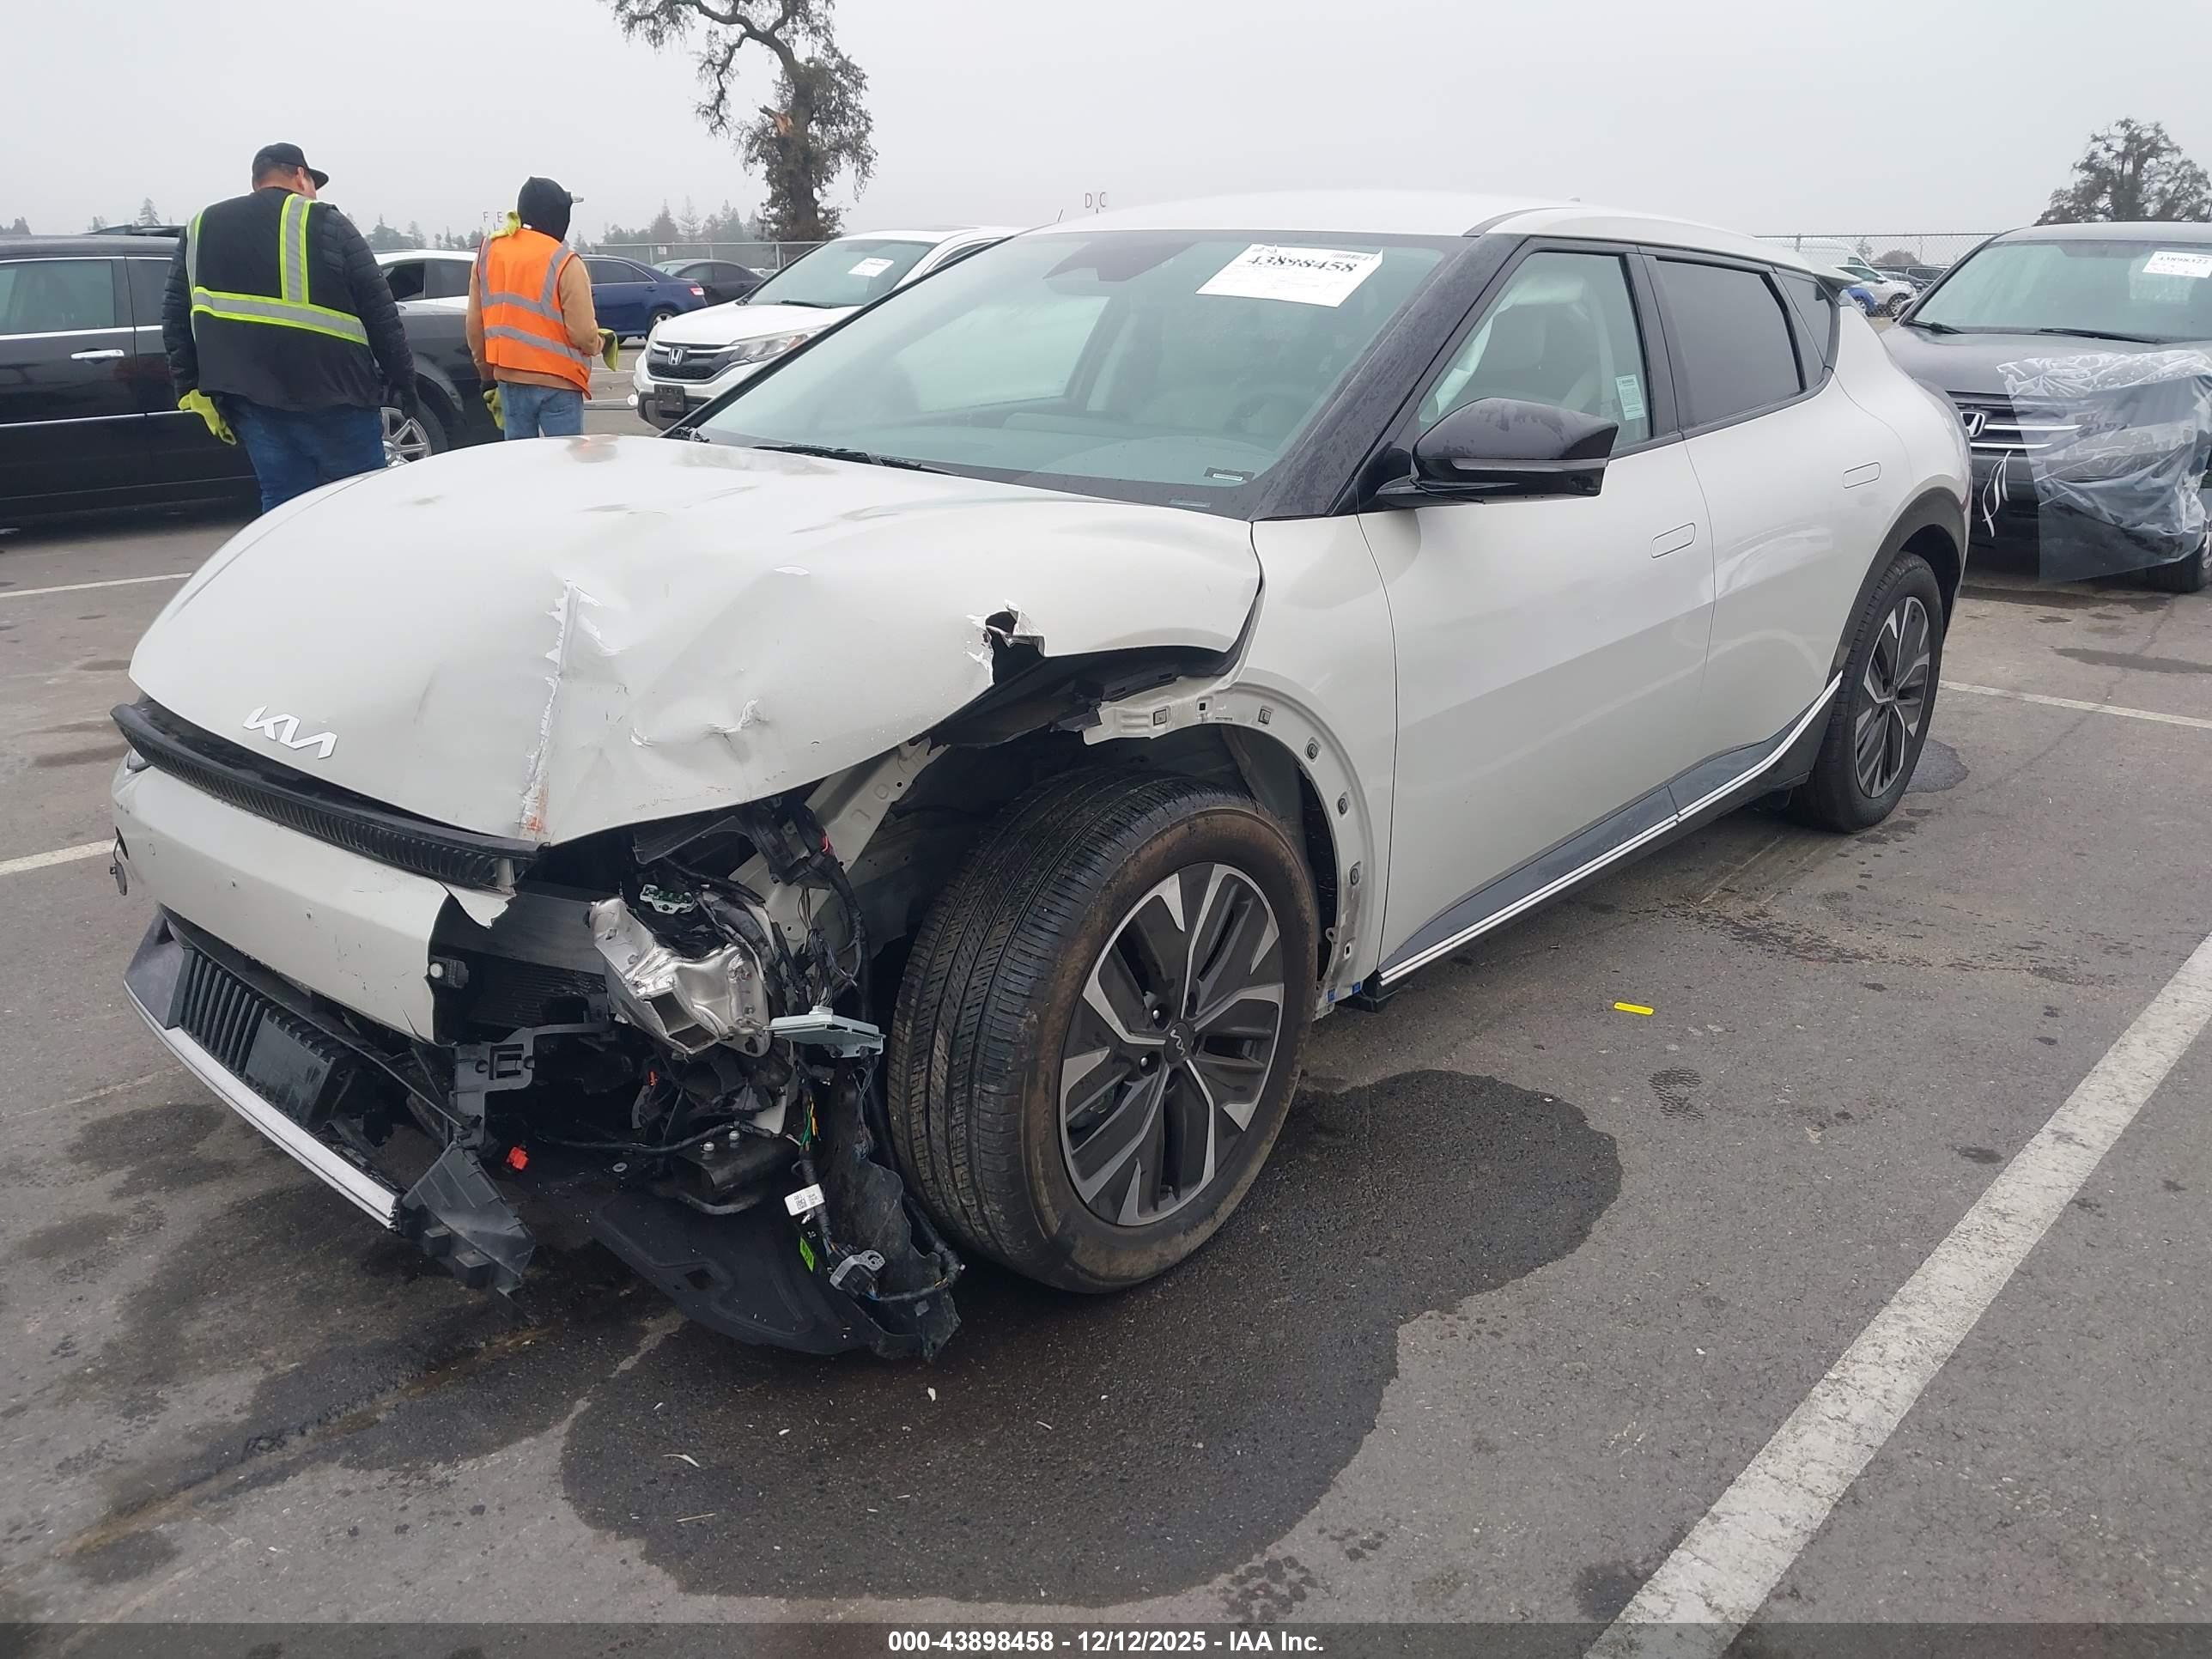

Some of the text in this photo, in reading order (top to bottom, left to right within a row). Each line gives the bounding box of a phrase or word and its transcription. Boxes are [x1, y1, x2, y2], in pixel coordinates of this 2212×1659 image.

[1085, 192, 1093, 209] D
[483, 210, 503, 223] F E
[1246, 255, 1358, 273] 43898458
